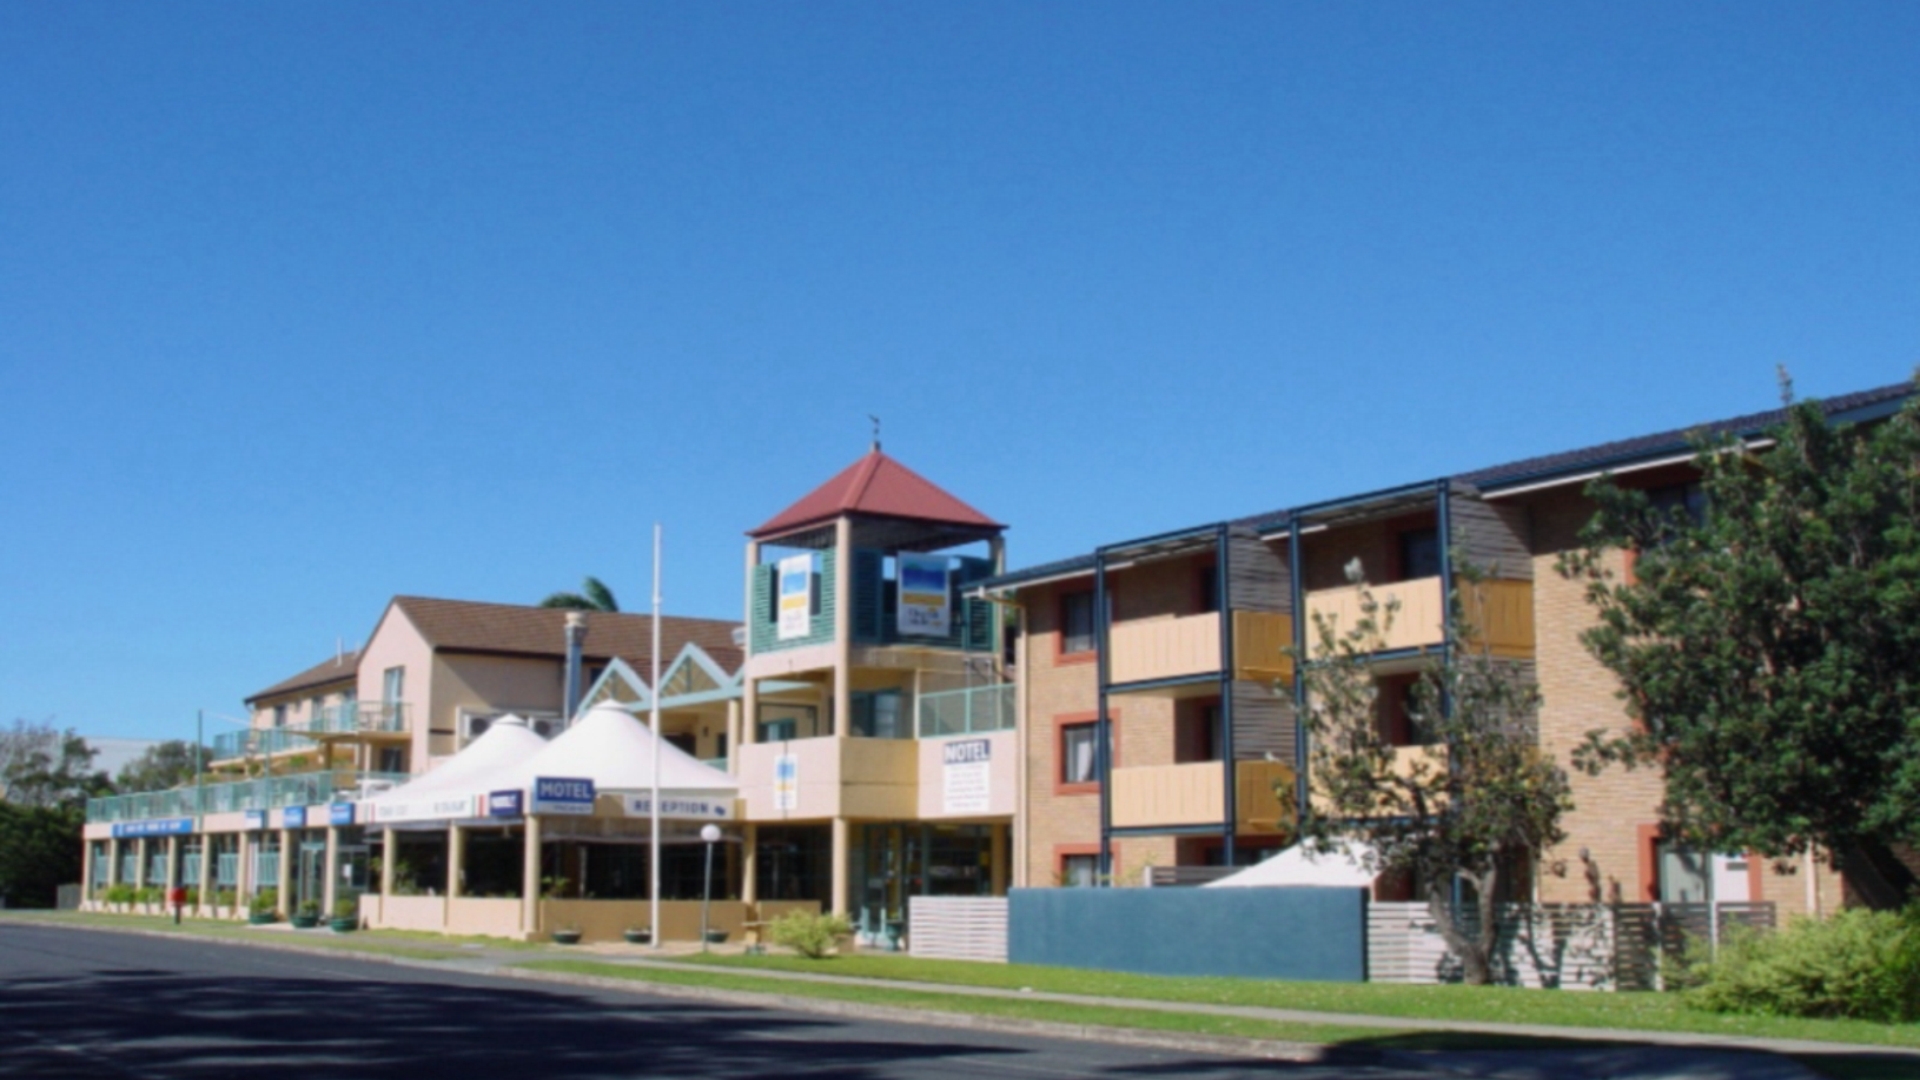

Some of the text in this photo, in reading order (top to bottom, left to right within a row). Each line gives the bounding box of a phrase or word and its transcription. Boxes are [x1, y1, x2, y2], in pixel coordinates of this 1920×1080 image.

[945, 742, 988, 762] MOTEL
[541, 782, 591, 799] MOTEL
[635, 800, 709, 814] REEPTION
